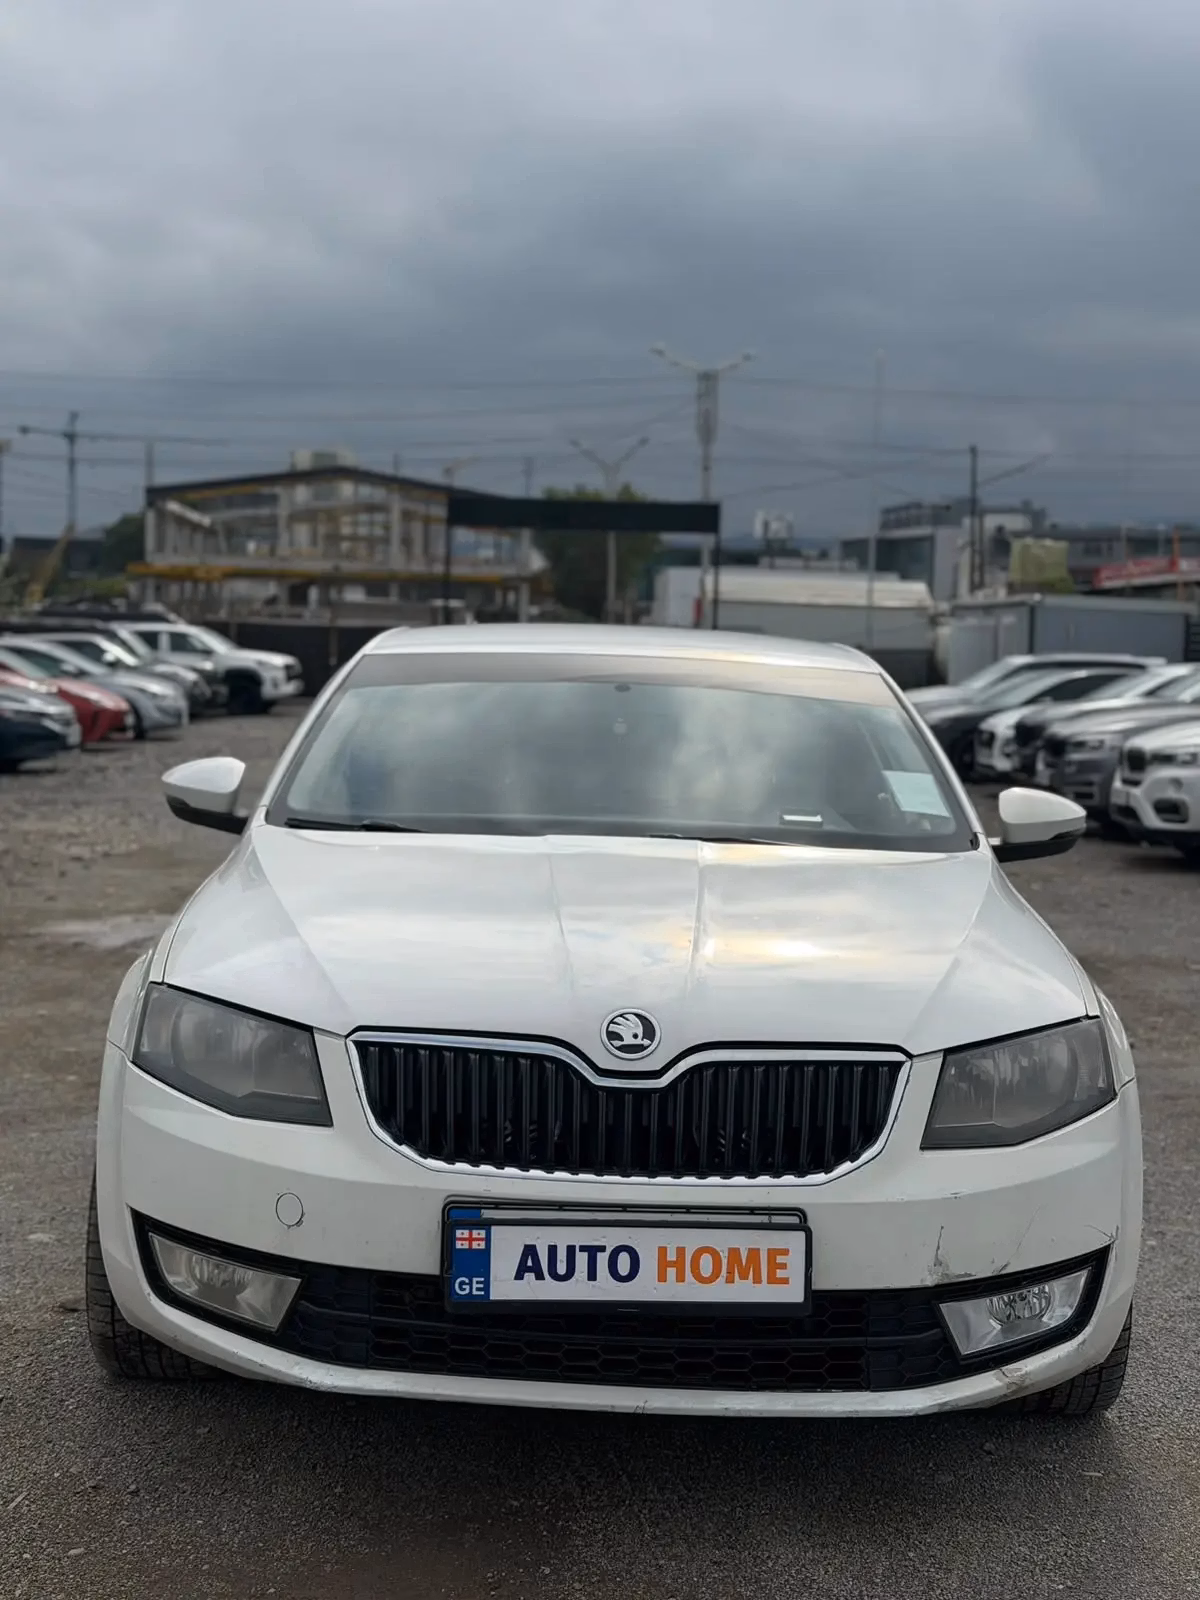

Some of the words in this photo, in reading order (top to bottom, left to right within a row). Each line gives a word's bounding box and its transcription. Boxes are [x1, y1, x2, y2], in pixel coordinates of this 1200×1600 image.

[513, 1243, 641, 1283] AUTO
[657, 1246, 791, 1285] HOME
[454, 1277, 485, 1296] GE
